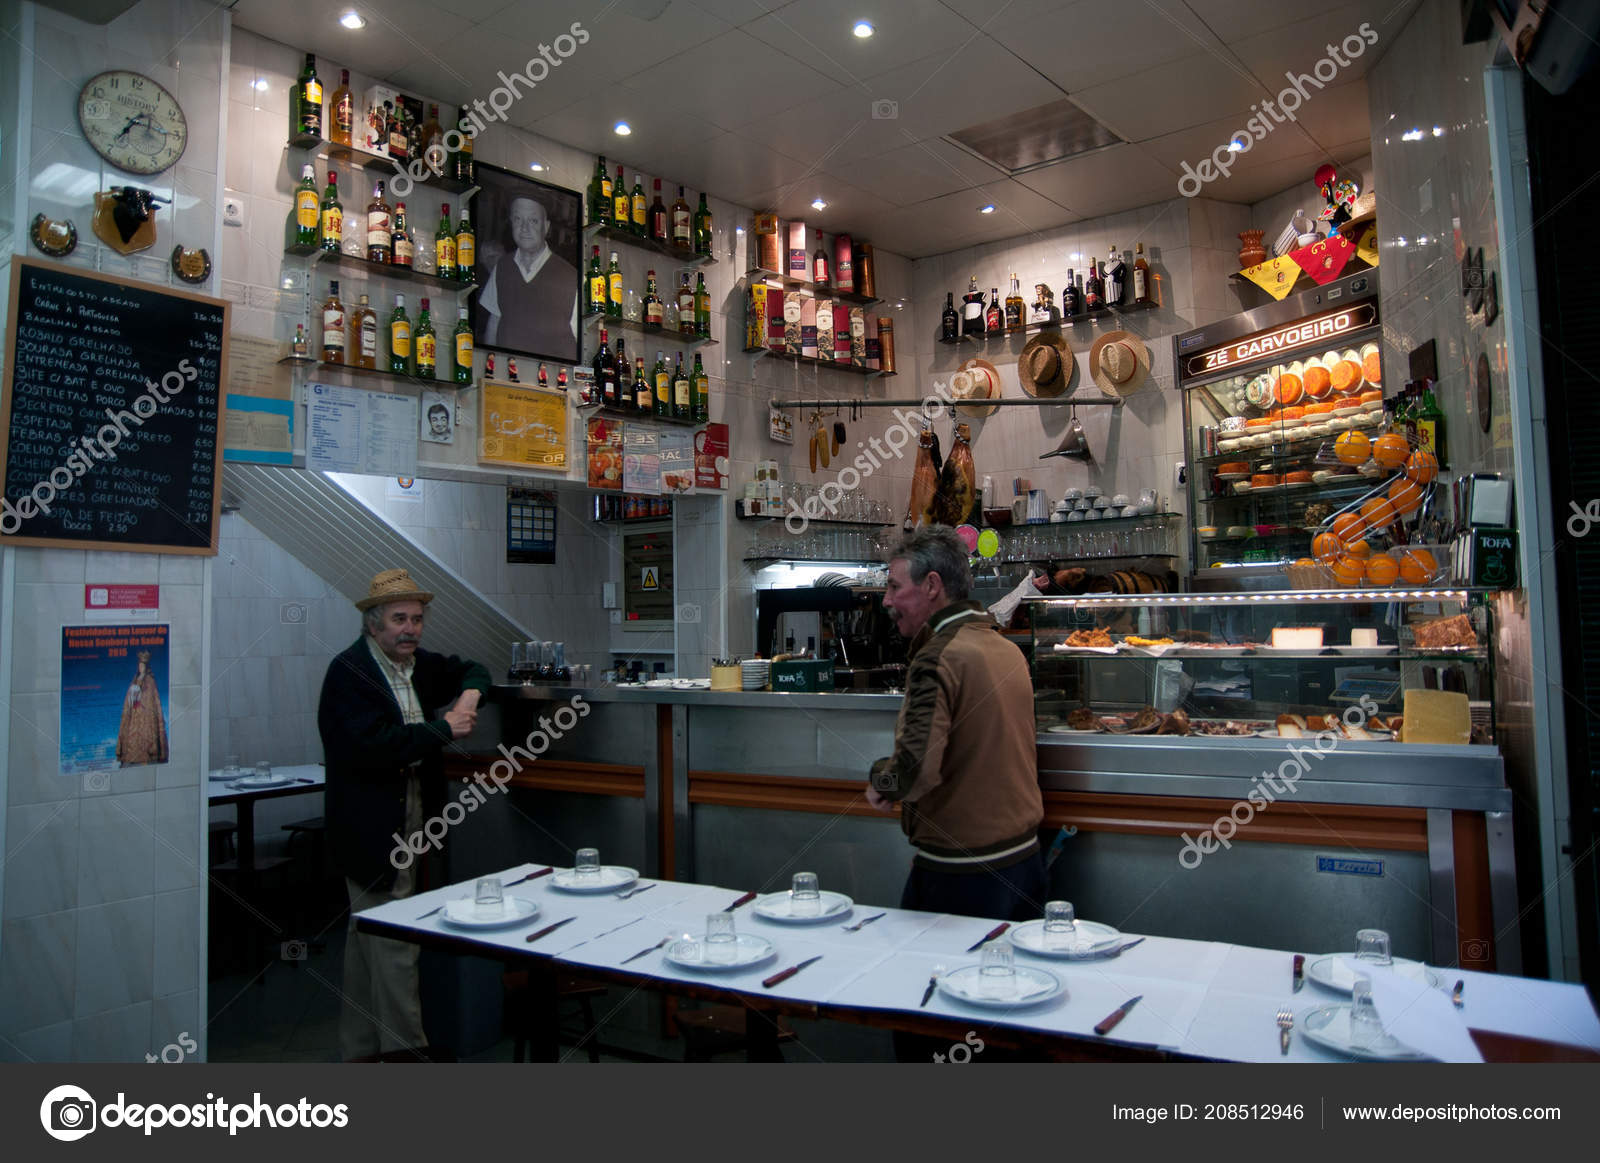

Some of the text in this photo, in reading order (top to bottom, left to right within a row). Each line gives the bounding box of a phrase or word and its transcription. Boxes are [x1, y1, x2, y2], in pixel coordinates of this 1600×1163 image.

[1206, 351, 1229, 368] ZÉ
[1236, 314, 1350, 359] CARVOEIRO
[1480, 536, 1512, 549] TOFA
